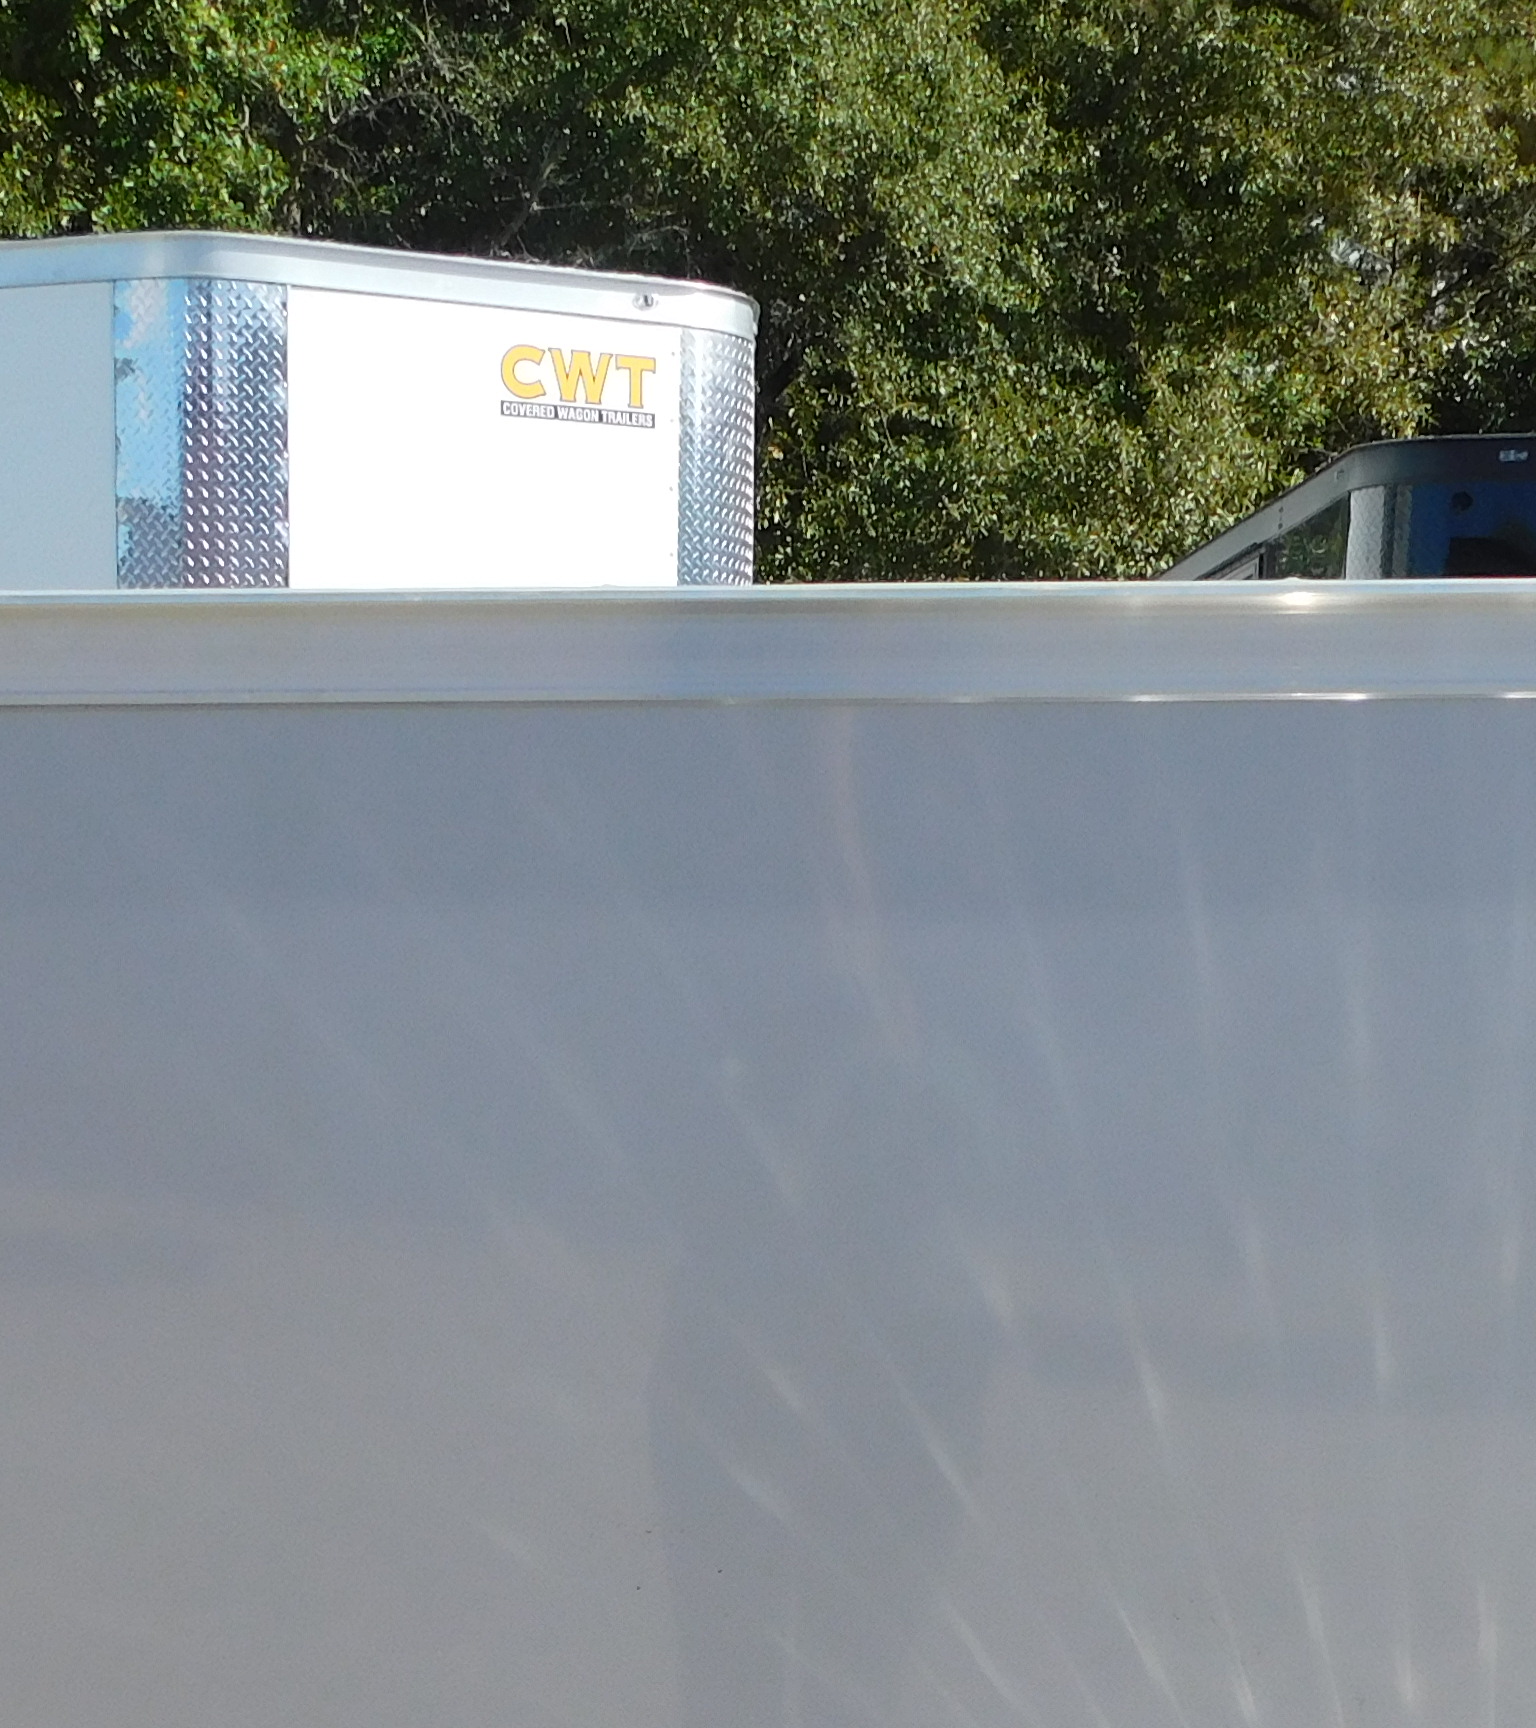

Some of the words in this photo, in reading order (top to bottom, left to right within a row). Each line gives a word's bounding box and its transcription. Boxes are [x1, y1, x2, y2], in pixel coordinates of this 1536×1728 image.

[500, 344, 656, 409] CWT
[502, 402, 555, 419] COVERED
[556, 406, 599, 423] WAGON
[601, 410, 654, 428] TRAILERS
